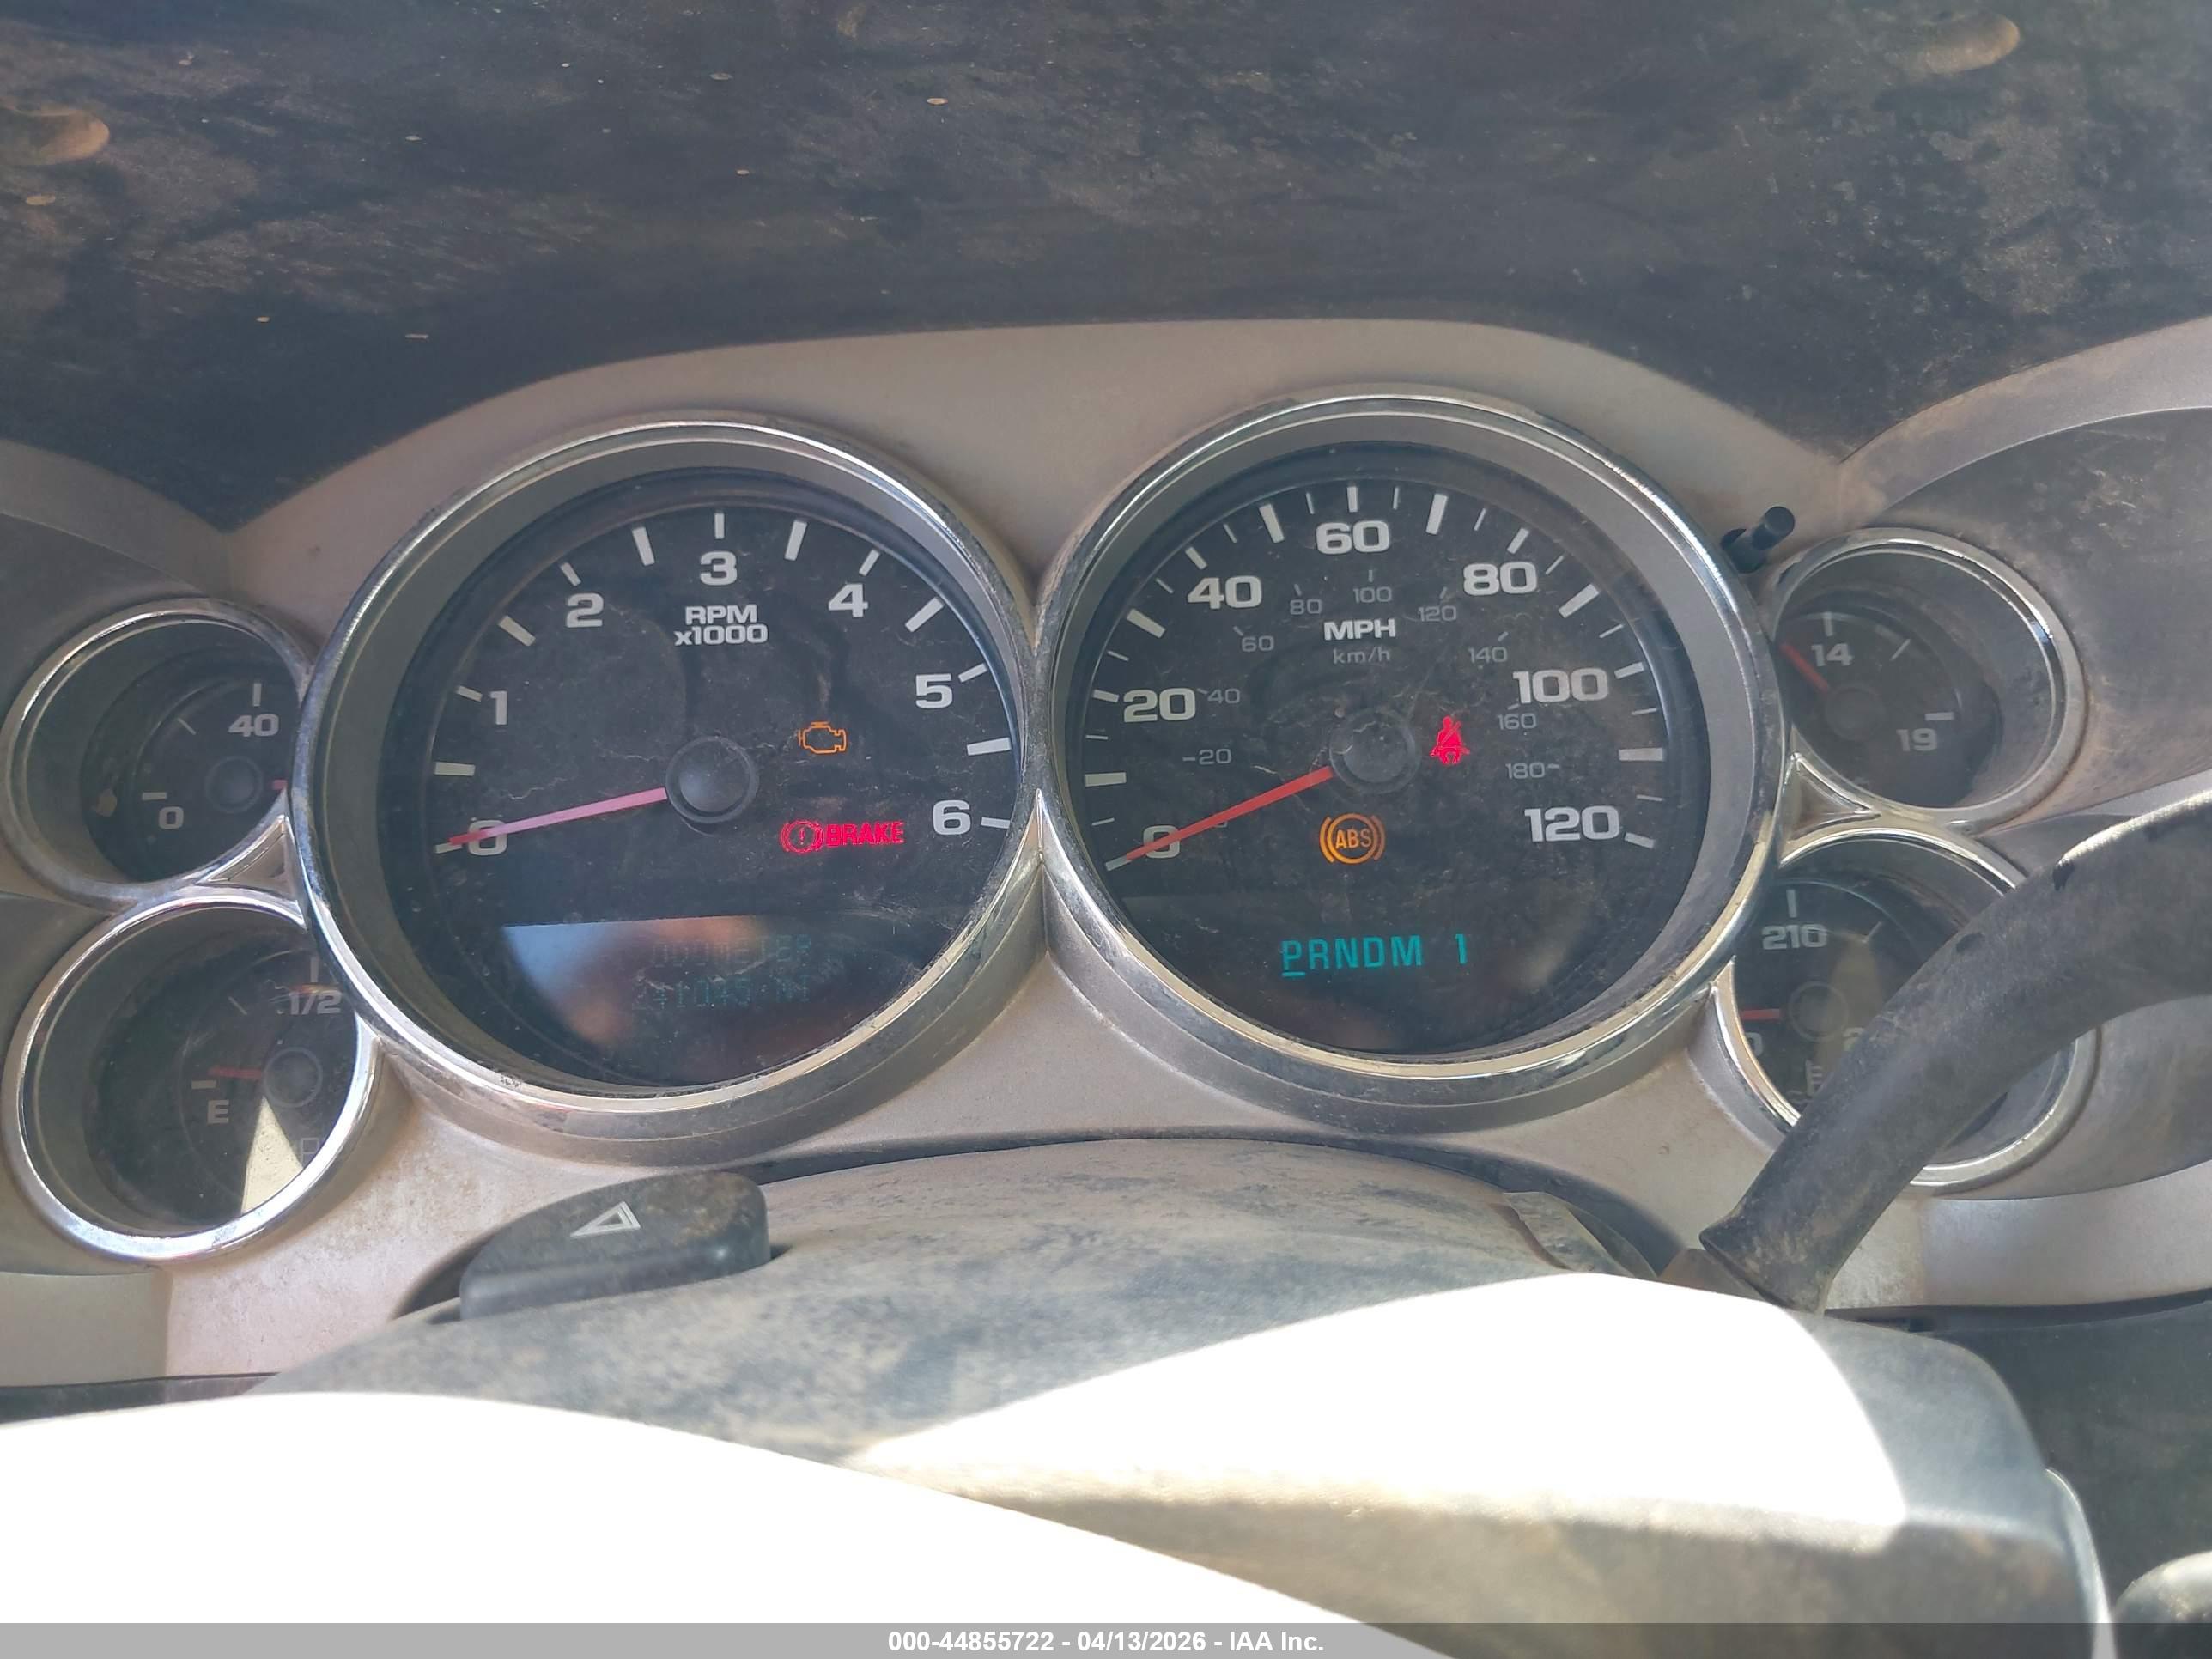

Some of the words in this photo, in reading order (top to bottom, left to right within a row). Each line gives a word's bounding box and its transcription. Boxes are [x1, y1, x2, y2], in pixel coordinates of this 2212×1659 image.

[1316, 520, 1389, 554] 60
[700, 551, 737, 585] 3
[1464, 562, 1537, 595] 80
[829, 583, 868, 617] 4
[1188, 576, 1261, 609] 40
[1353, 586, 1392, 603] 100
[567, 593, 603, 628] 2
[686, 605, 757, 623] RPM
[1291, 599, 1322, 614] 80
[1419, 605, 1456, 622] 120
[675, 623, 768, 646] x1000
[1324, 618, 1395, 640] MPH
[1242, 635, 1274, 652] 60
[1468, 647, 1507, 663] 140
[1812, 643, 1853, 666] 14
[1334, 647, 1390, 664] km/h
[916, 674, 952, 708] 5
[1208, 689, 1240, 703] 40
[1512, 668, 1608, 702] 100
[490, 691, 507, 725] 1
[1124, 688, 1195, 722] 20
[228, 714, 278, 737] 40
[1498, 713, 1537, 730] 160
[1898, 728, 1939, 750] 19
[1200, 749, 1231, 764] 20
[1506, 762, 1545, 778] 180
[159, 806, 184, 829] 0
[933, 800, 970, 835] 6
[1525, 806, 1620, 842] 120
[468, 820, 507, 855] 0
[825, 822, 902, 847] BRAKE
[1143, 825, 1180, 858] 0
[1335, 830, 1372, 849] ABS
[1763, 924, 1828, 949] 210
[1455, 933, 1468, 964] 1
[289, 990, 342, 1015] 1/2
[208, 1100, 229, 1123] E
